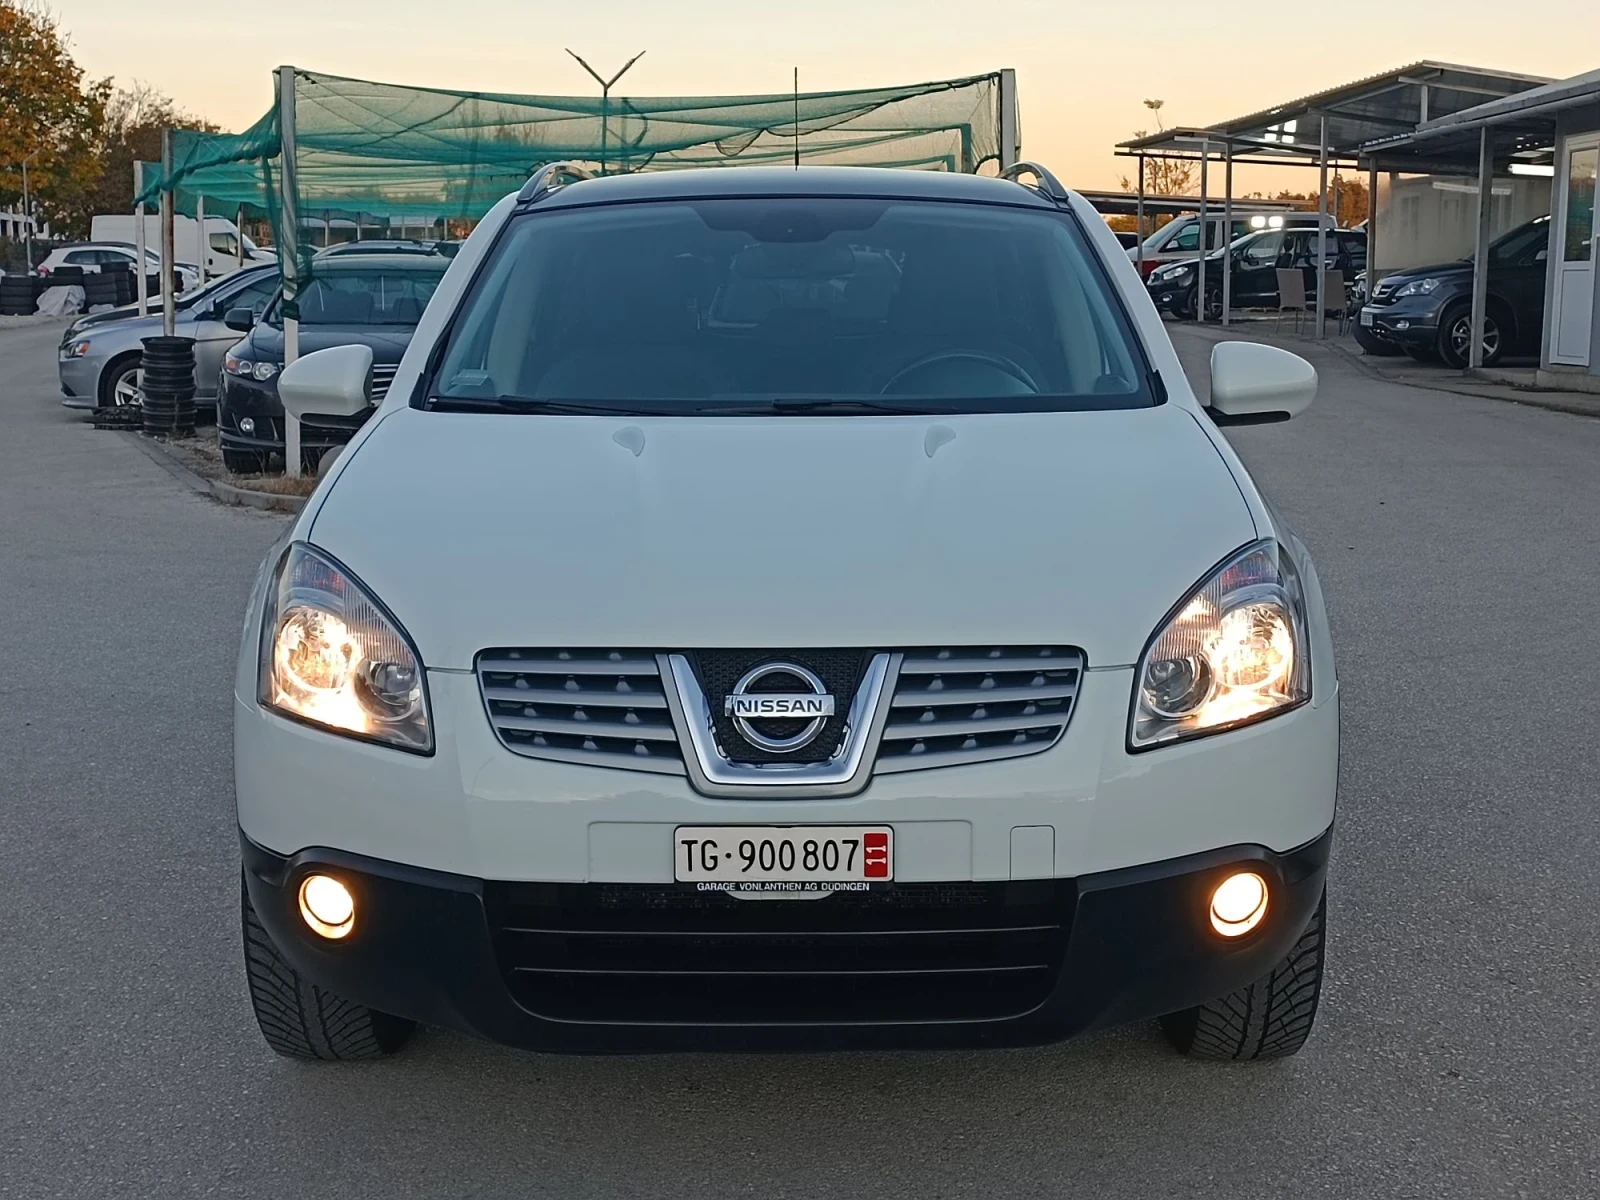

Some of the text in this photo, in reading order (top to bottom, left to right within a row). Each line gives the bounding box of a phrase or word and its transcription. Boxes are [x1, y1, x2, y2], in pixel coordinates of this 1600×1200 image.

[736, 699, 823, 713] NISSAN
[865, 844, 887, 866] 11
[696, 882, 736, 891] GARAGE
[739, 882, 802, 891] VONLANTHEN
[804, 882, 818, 891] AG
